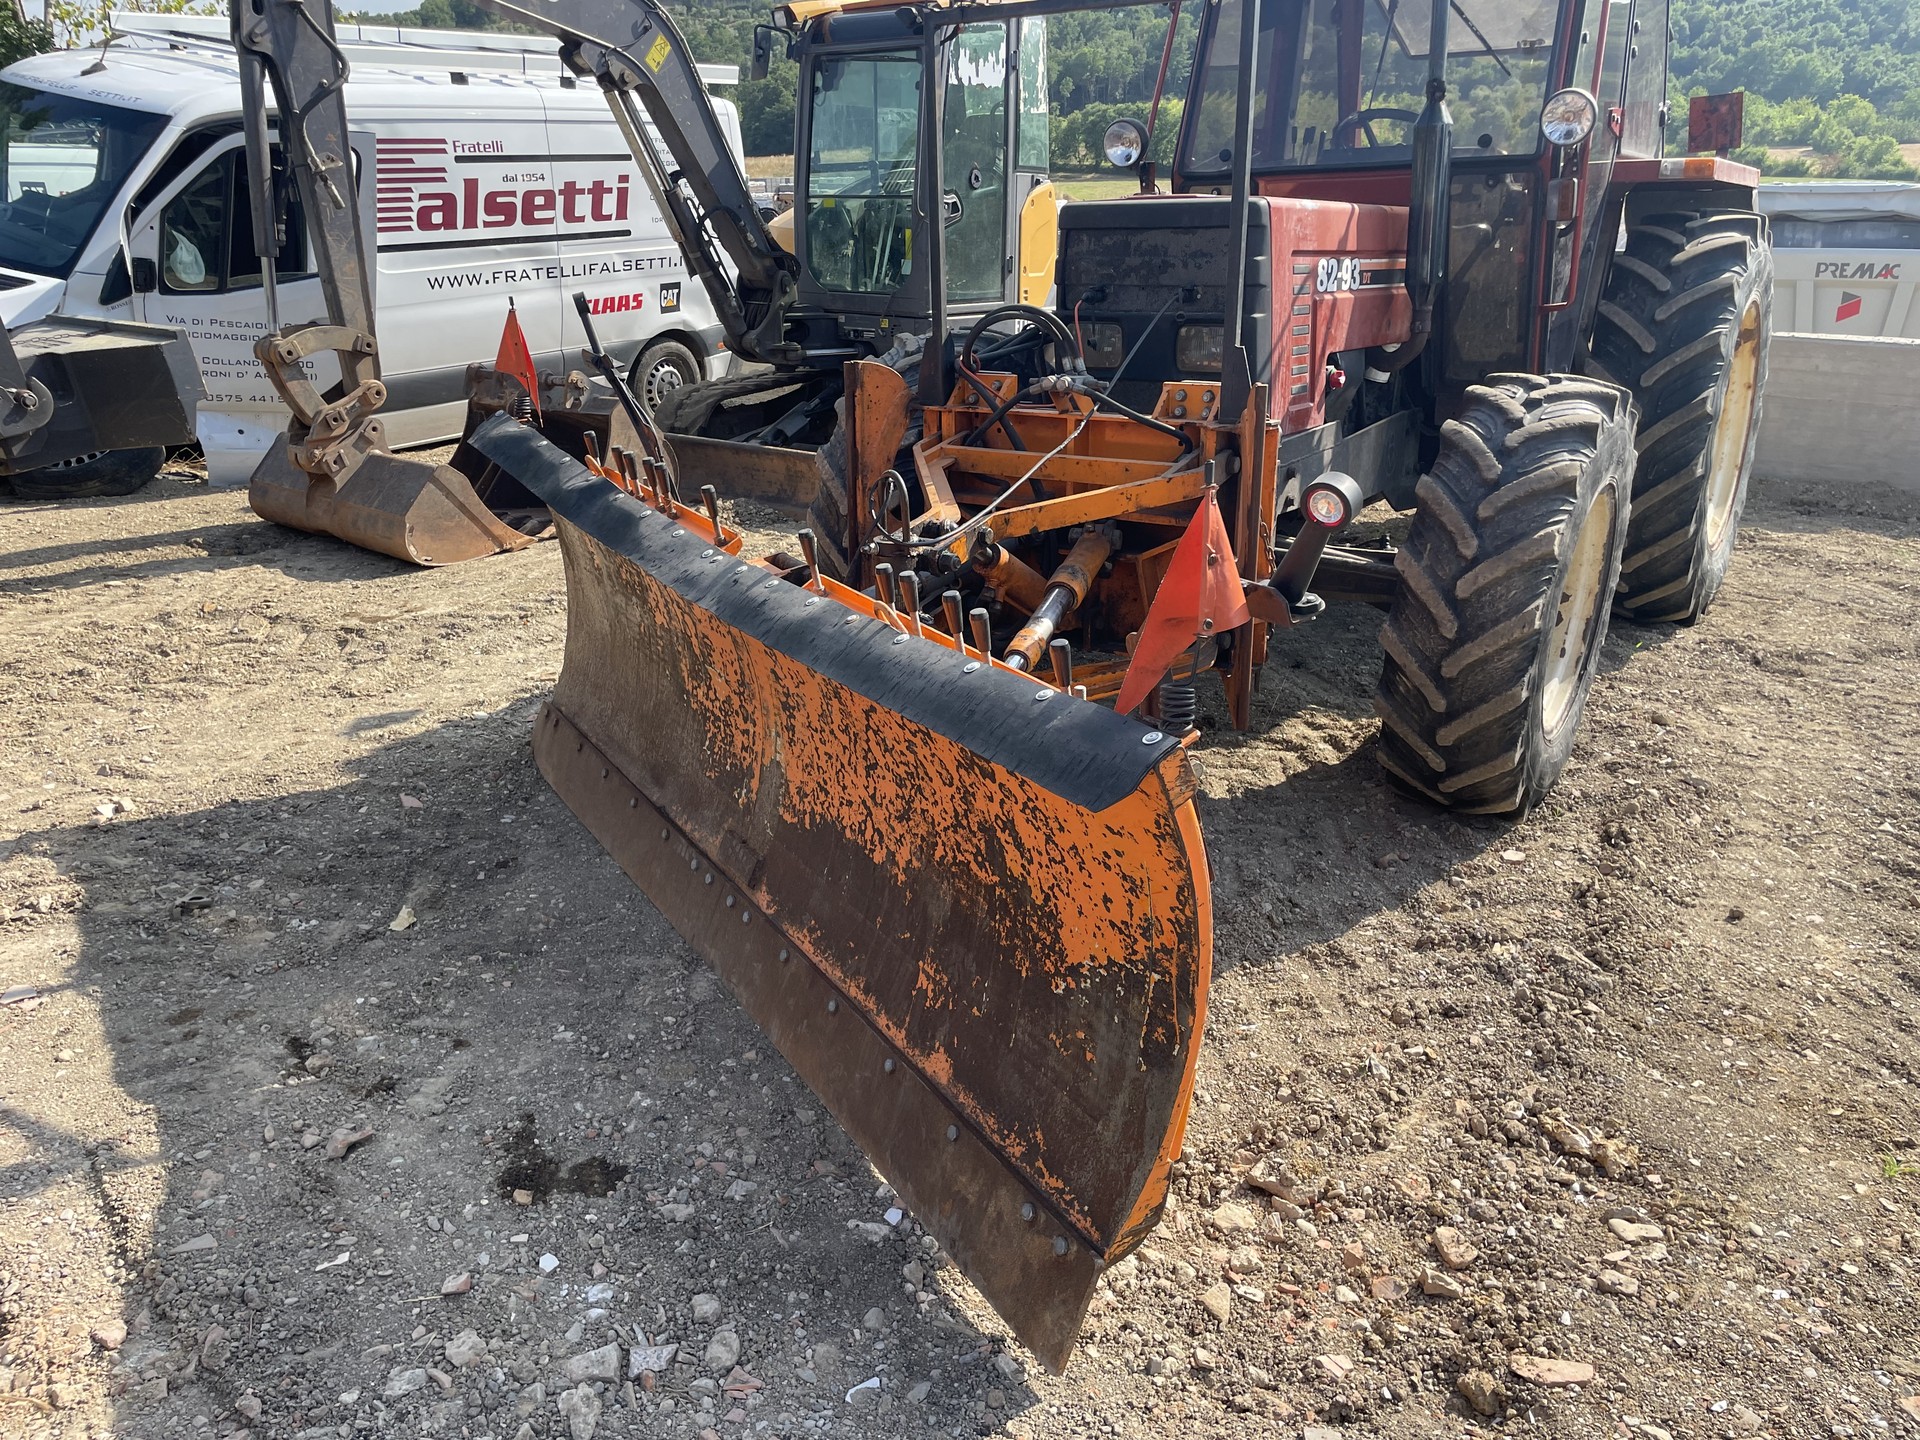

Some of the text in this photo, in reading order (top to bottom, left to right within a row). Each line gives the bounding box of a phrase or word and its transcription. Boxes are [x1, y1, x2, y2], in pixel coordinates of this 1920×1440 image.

[452, 140, 504, 154] Fratelli
[502, 173, 546, 183] dal 1954
[427, 256, 684, 290] WWW.FRATELLIFALSETTI.I
[1316, 258, 1372, 292] 82-93 DT
[1814, 262, 1902, 280] PREMAC
[661, 288, 680, 308] CAT
[166, 314, 269, 330] VIA DI PESCAIOL
[188, 331, 260, 342] ICIOMAGGIO
[201, 370, 231, 378] RONI
[249, 395, 286, 404] 4415
